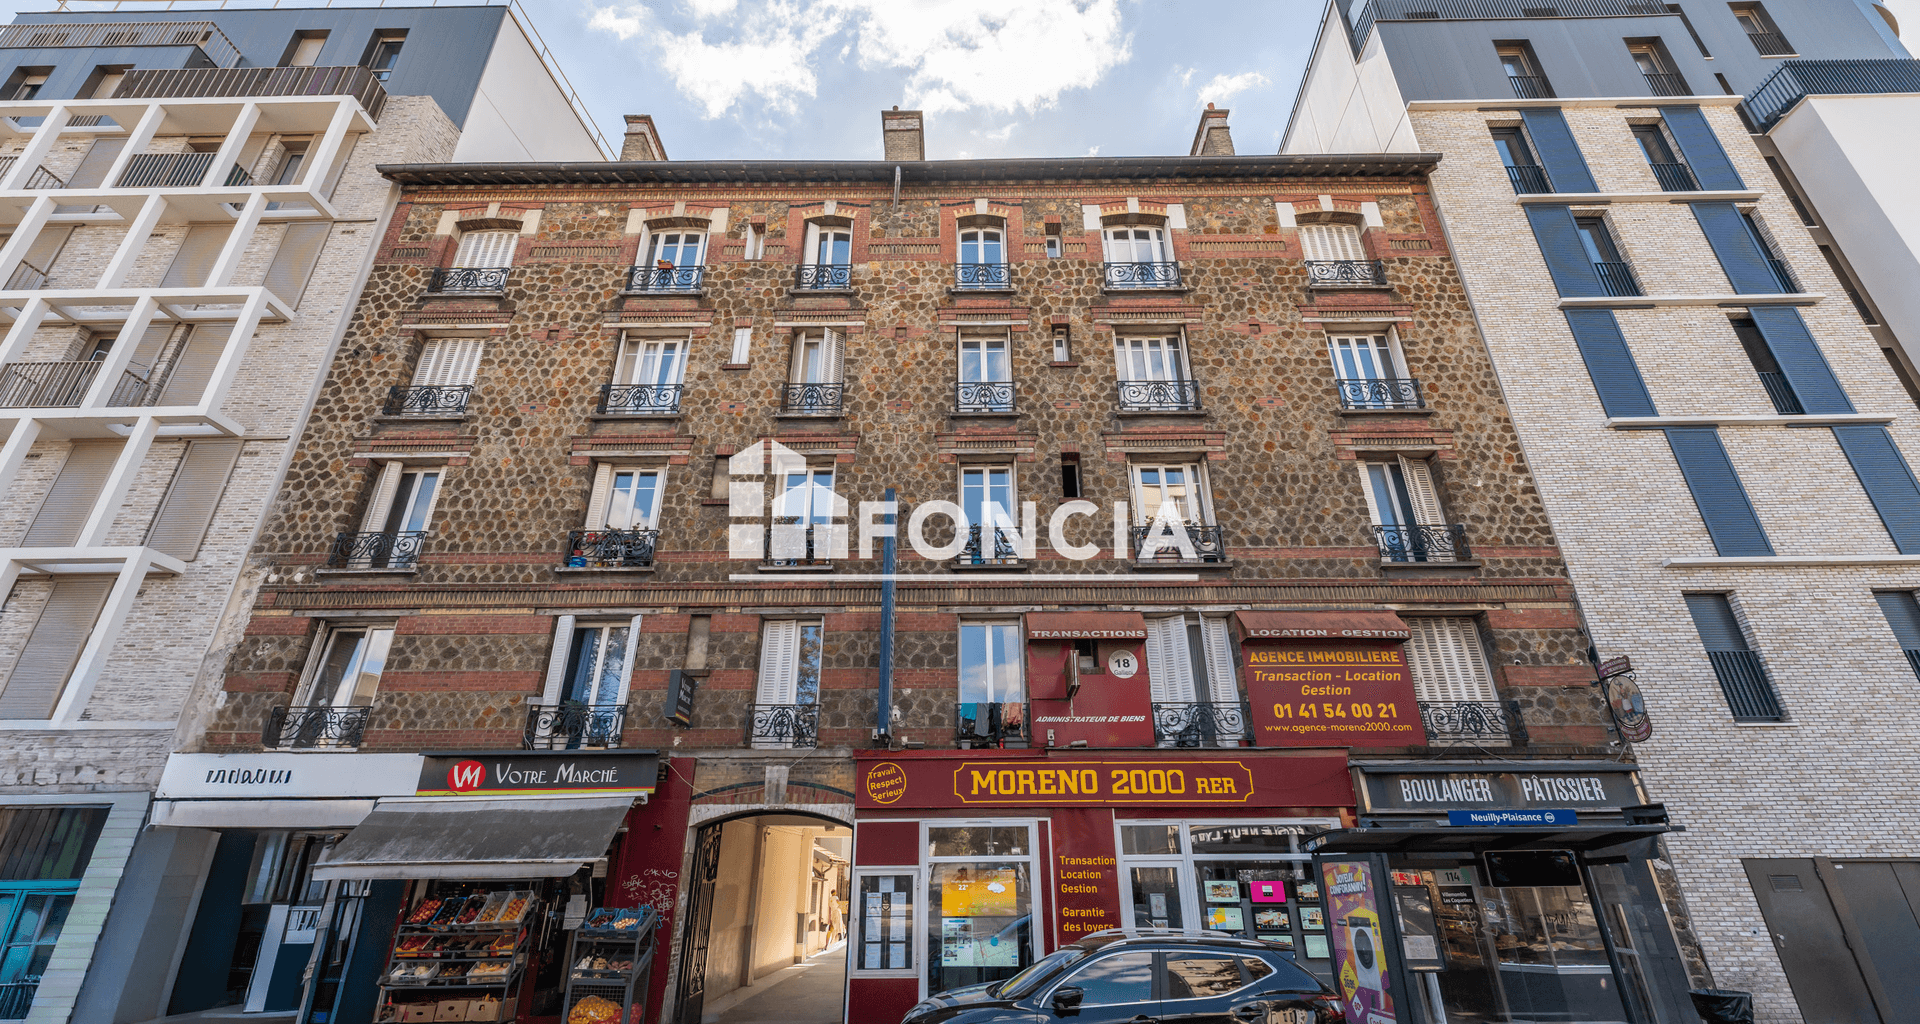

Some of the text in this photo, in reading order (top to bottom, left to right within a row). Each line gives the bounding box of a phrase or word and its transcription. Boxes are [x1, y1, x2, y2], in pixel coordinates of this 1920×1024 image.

[1031, 630, 1146, 638] TRANSACTIONS
[1250, 629, 1327, 637] LOCATION
[1341, 629, 1410, 638] GESTION
[1250, 651, 1400, 663] AGENCE IMMOBILIERE
[1114, 658, 1130, 668] 18
[1254, 670, 1332, 681] Transaction
[1345, 670, 1401, 681] Location
[1301, 685, 1351, 696] Gestion
[1273, 703, 1397, 718] 01 41 54 00 21
[1264, 722, 1413, 734] www.agence-moreno2000.com
[868, 766, 896, 779] Travail
[870, 776, 903, 790] Respect
[970, 769, 1237, 795] MORENO 2000 RER
[1400, 774, 1607, 802] BOULANGER PÂTISSIER
[872, 788, 904, 801] Serieux
[1470, 813, 1542, 824] Neuilly-Plaisance
[1059, 855, 1116, 865] Transaction
[1060, 869, 1102, 879] Location
[1444, 871, 1460, 882] 114
[1061, 883, 1098, 893] Gestion
[1062, 907, 1105, 917] Garantie
[1063, 922, 1081, 932] des
